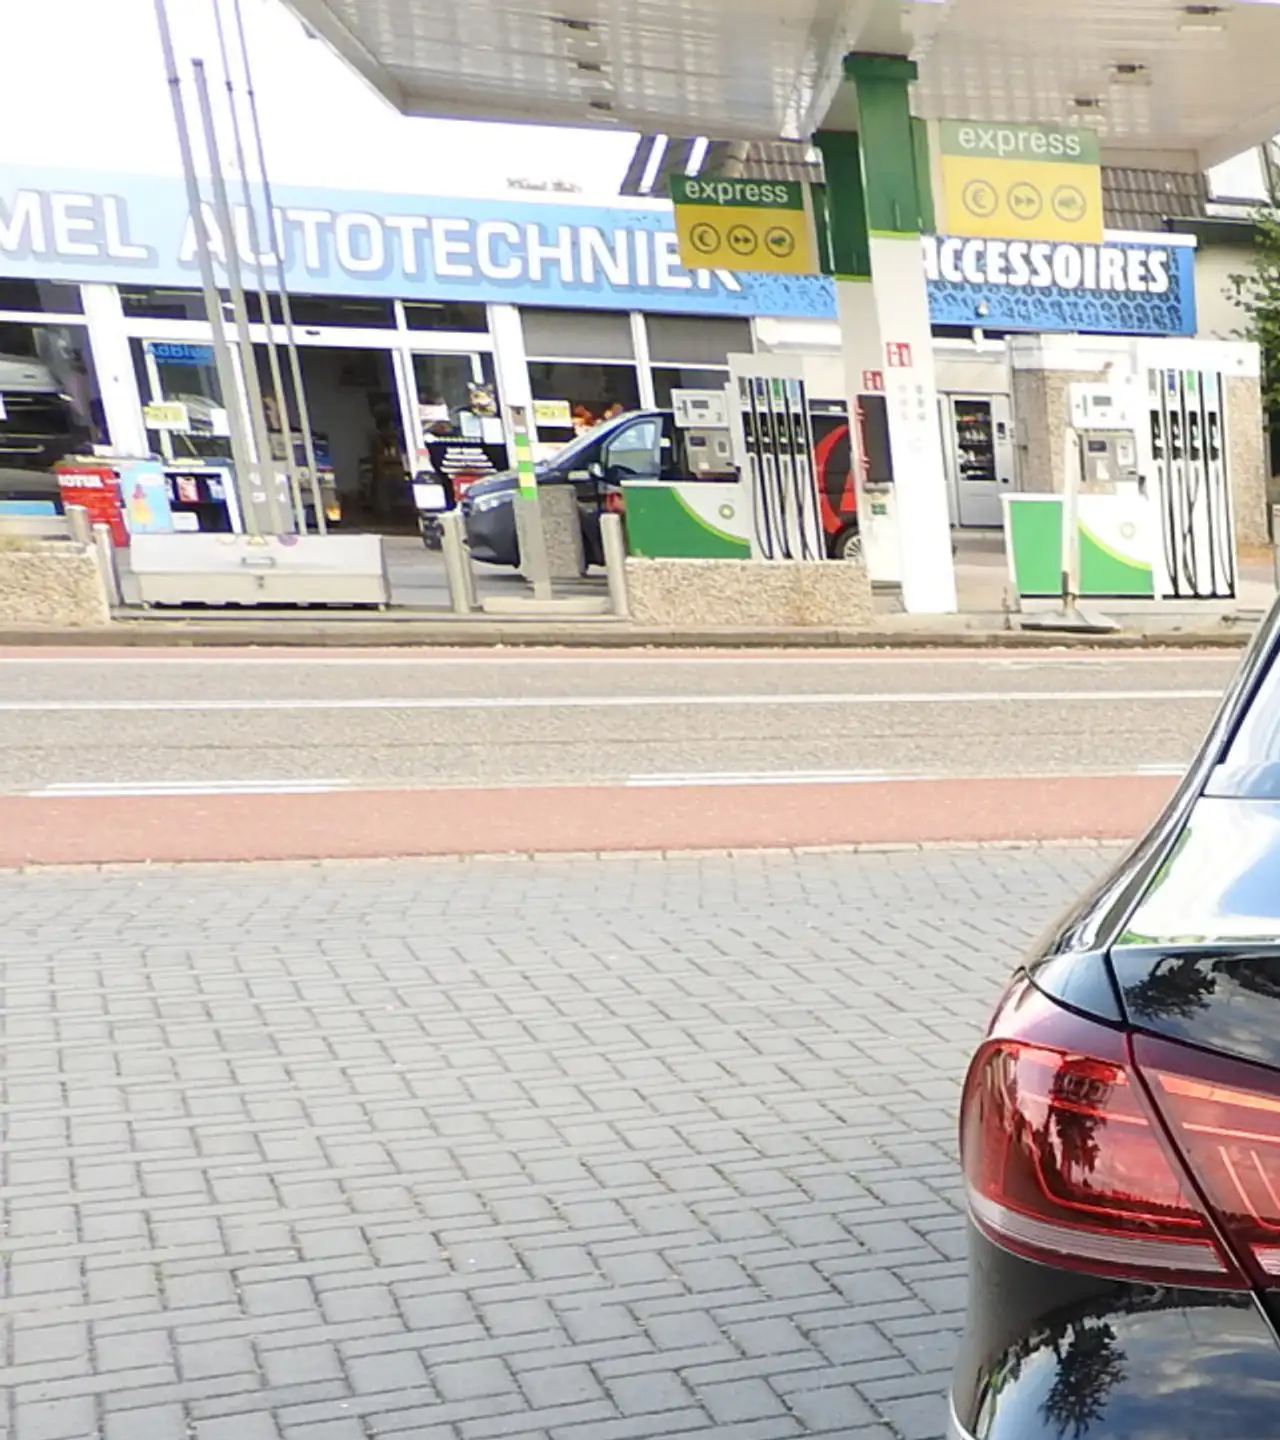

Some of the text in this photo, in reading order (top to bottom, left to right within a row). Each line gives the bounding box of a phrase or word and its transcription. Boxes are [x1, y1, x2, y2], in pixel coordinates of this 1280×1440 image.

[958, 125, 1081, 156] express
[685, 178, 789, 205] express
[178, 200, 743, 291] AUTOTECHNIE
